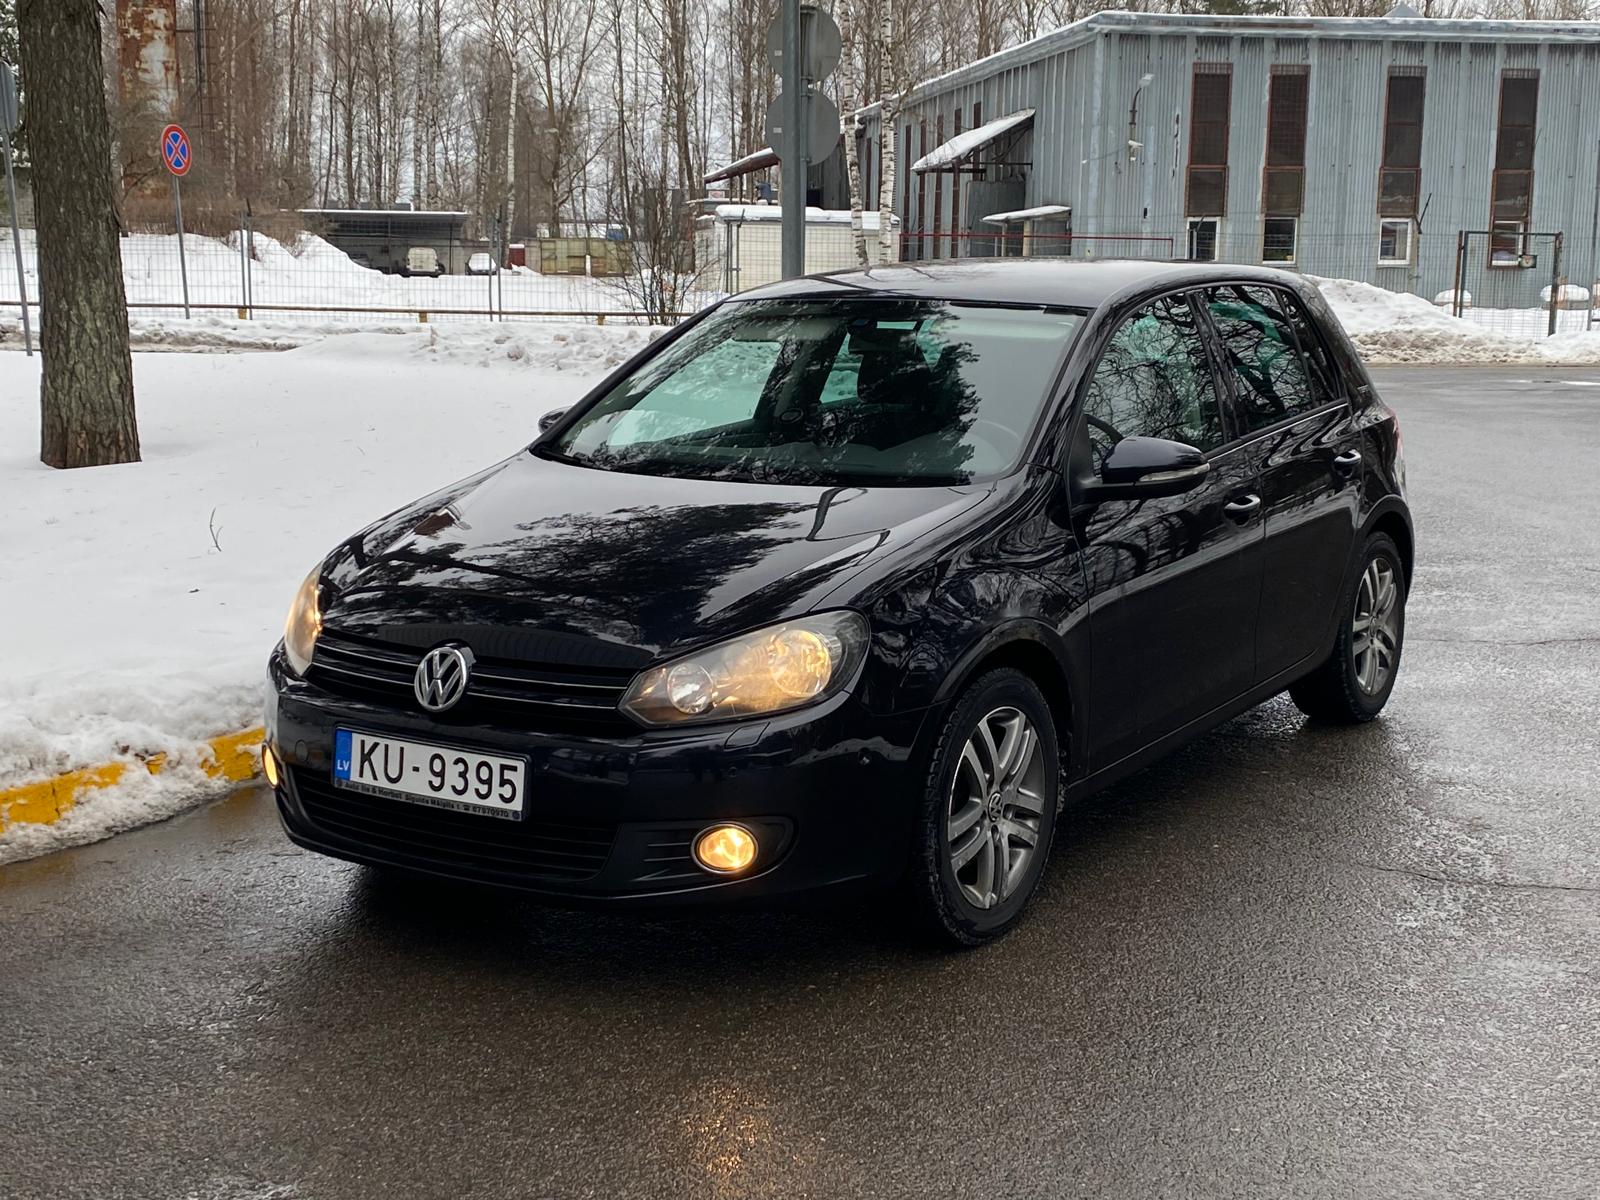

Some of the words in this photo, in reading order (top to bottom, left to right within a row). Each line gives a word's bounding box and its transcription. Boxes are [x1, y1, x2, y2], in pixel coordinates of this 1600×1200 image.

[414, 646, 467, 712] VW
[337, 760, 350, 772] LV
[358, 739, 518, 804] KU-9395
